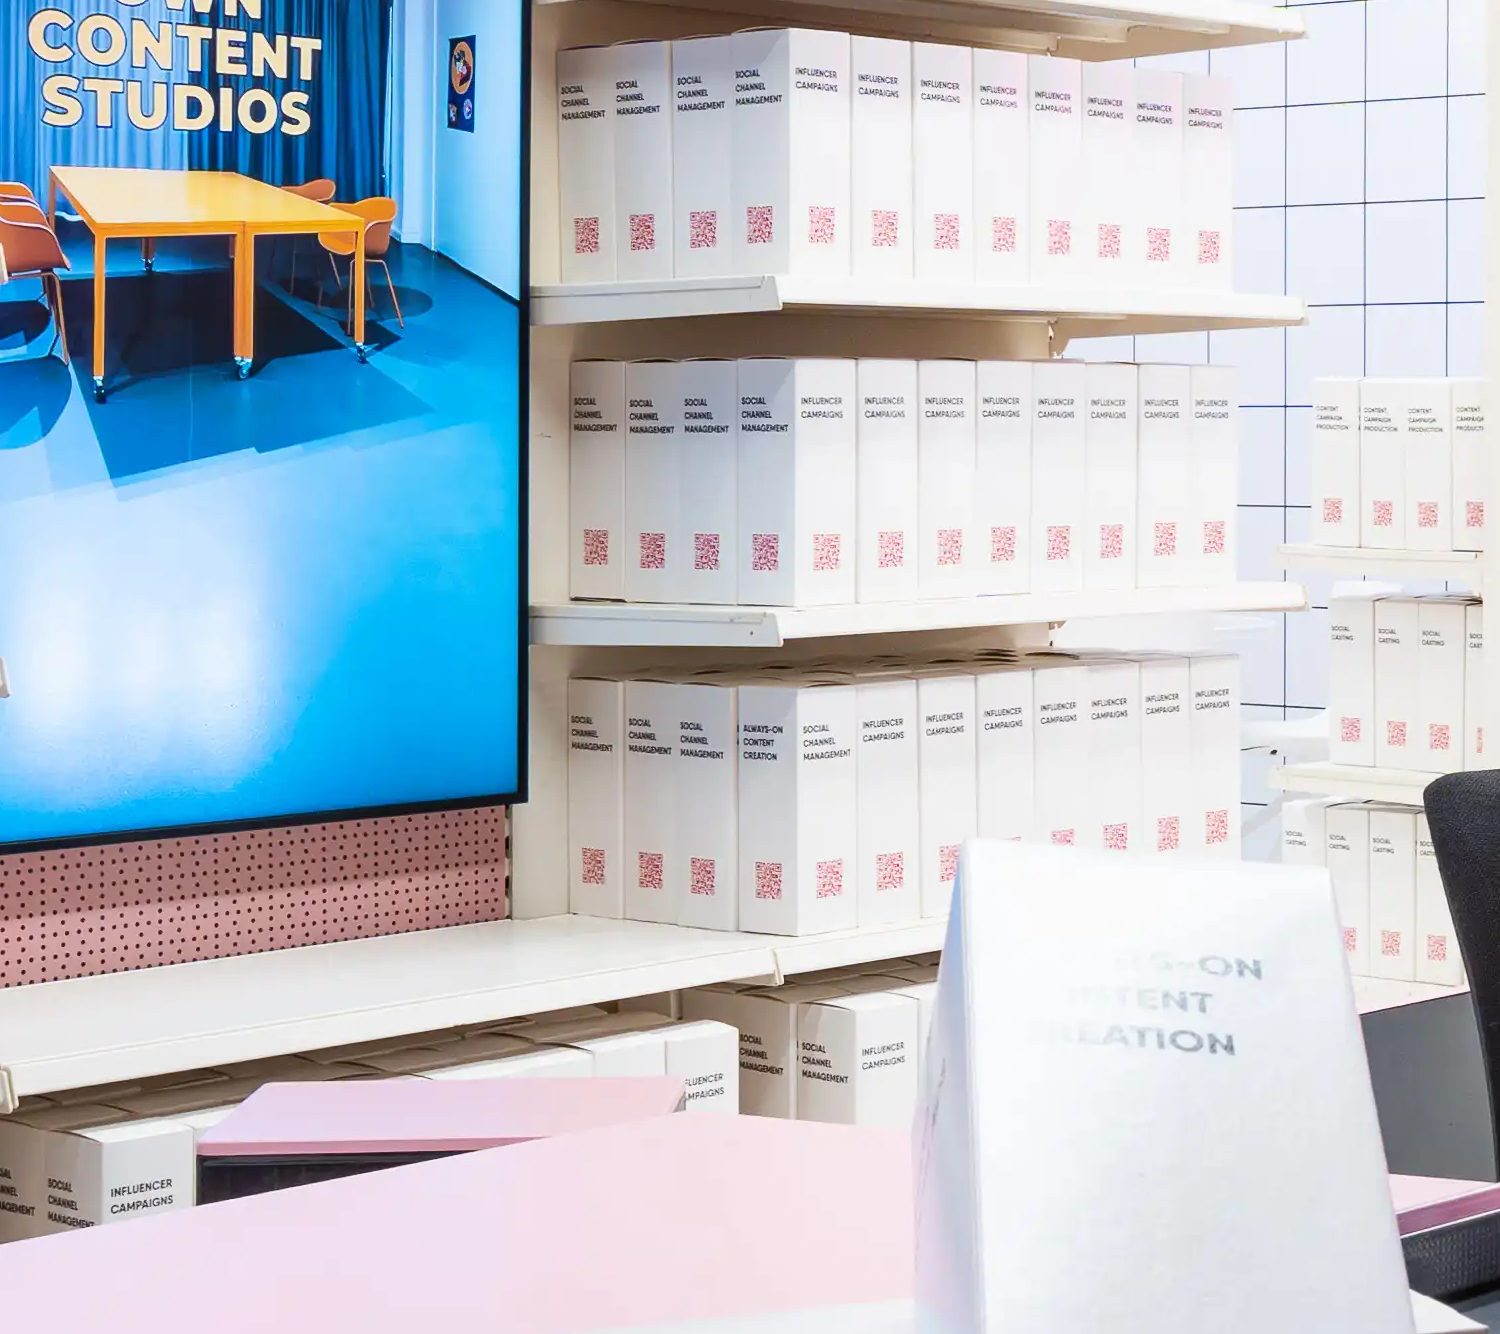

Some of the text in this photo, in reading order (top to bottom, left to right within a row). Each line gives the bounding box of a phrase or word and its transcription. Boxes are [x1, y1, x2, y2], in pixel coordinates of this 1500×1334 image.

[26, 7, 322, 80] CONTENT
[40, 73, 313, 137] STUDIOS
[741, 396, 767, 406] SOCIAL
[800, 396, 843, 405] INFLUENCER
[741, 410, 773, 419] CHANNEL
[800, 410, 844, 419] CAMPAIGNS
[741, 423, 789, 433] MANAGEMENT
[743, 724, 784, 734] ALWAYS-ON
[743, 737, 775, 748] CONTENT
[742, 751, 778, 761] CREATION
